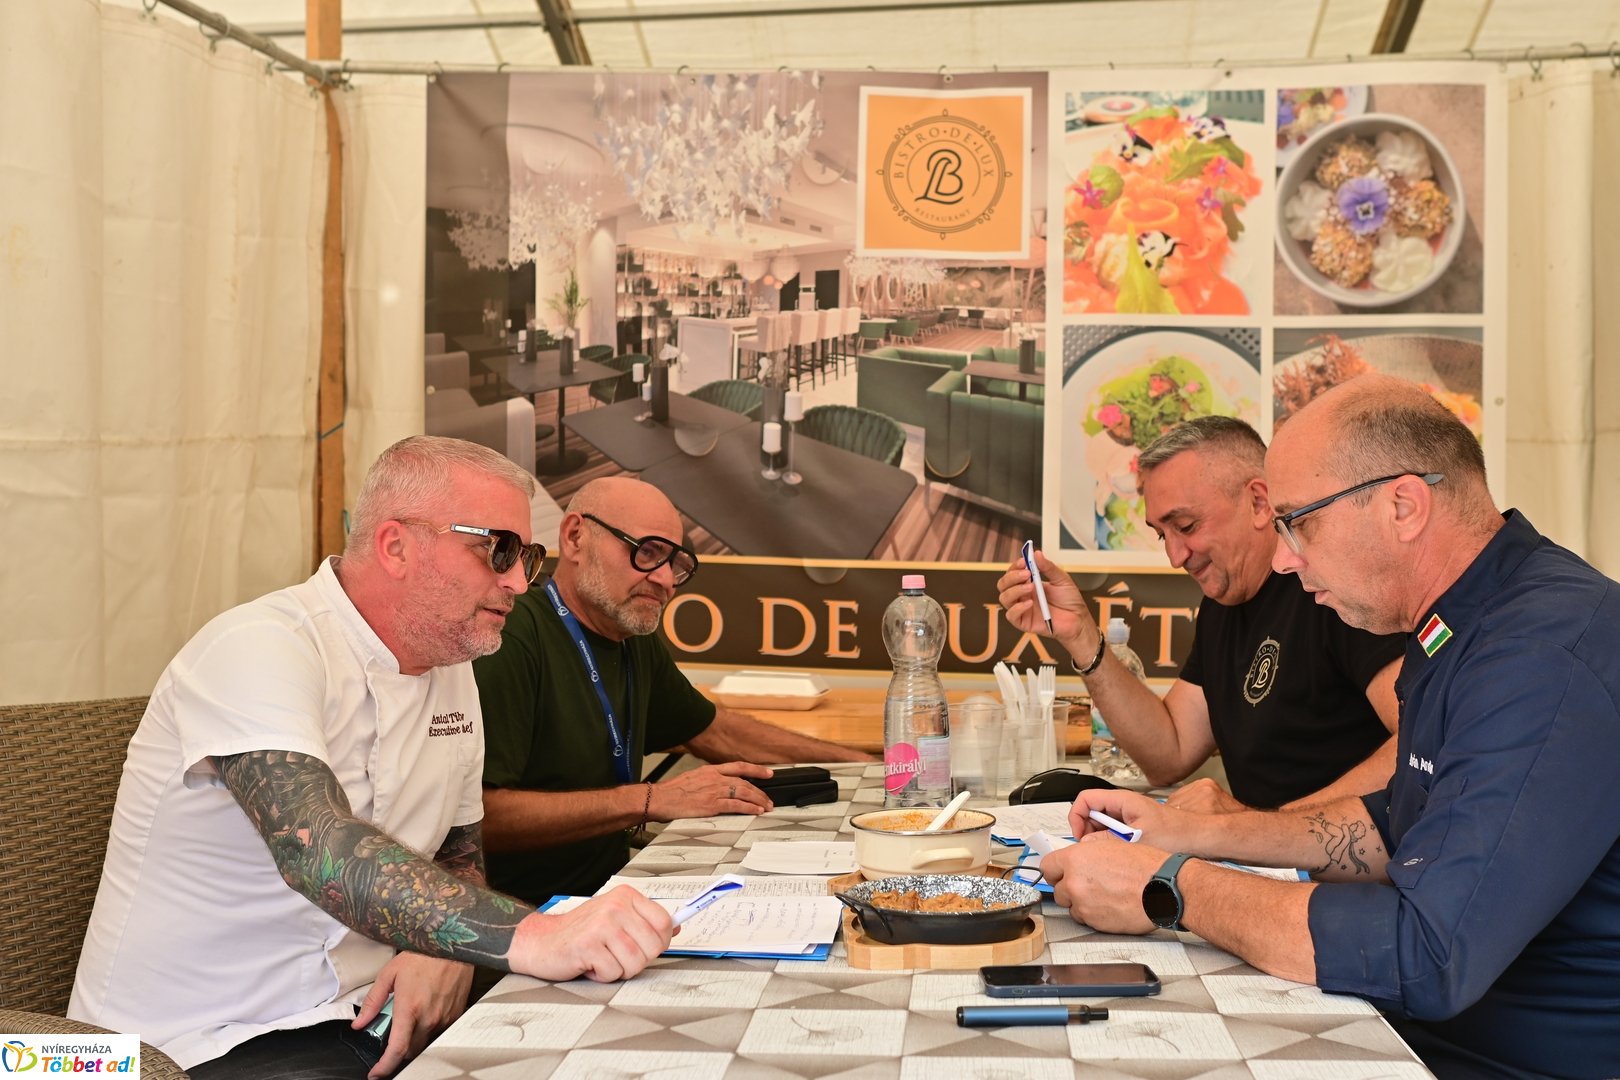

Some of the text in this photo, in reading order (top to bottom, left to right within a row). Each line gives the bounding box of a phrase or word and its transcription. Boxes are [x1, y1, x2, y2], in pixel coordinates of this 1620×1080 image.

[893, 127, 994, 179] BISTRO DE LUX
[914, 207, 971, 222] RESTAURANT
[757, 597, 861, 659] DE
[1093, 581, 1199, 667] ÉT
